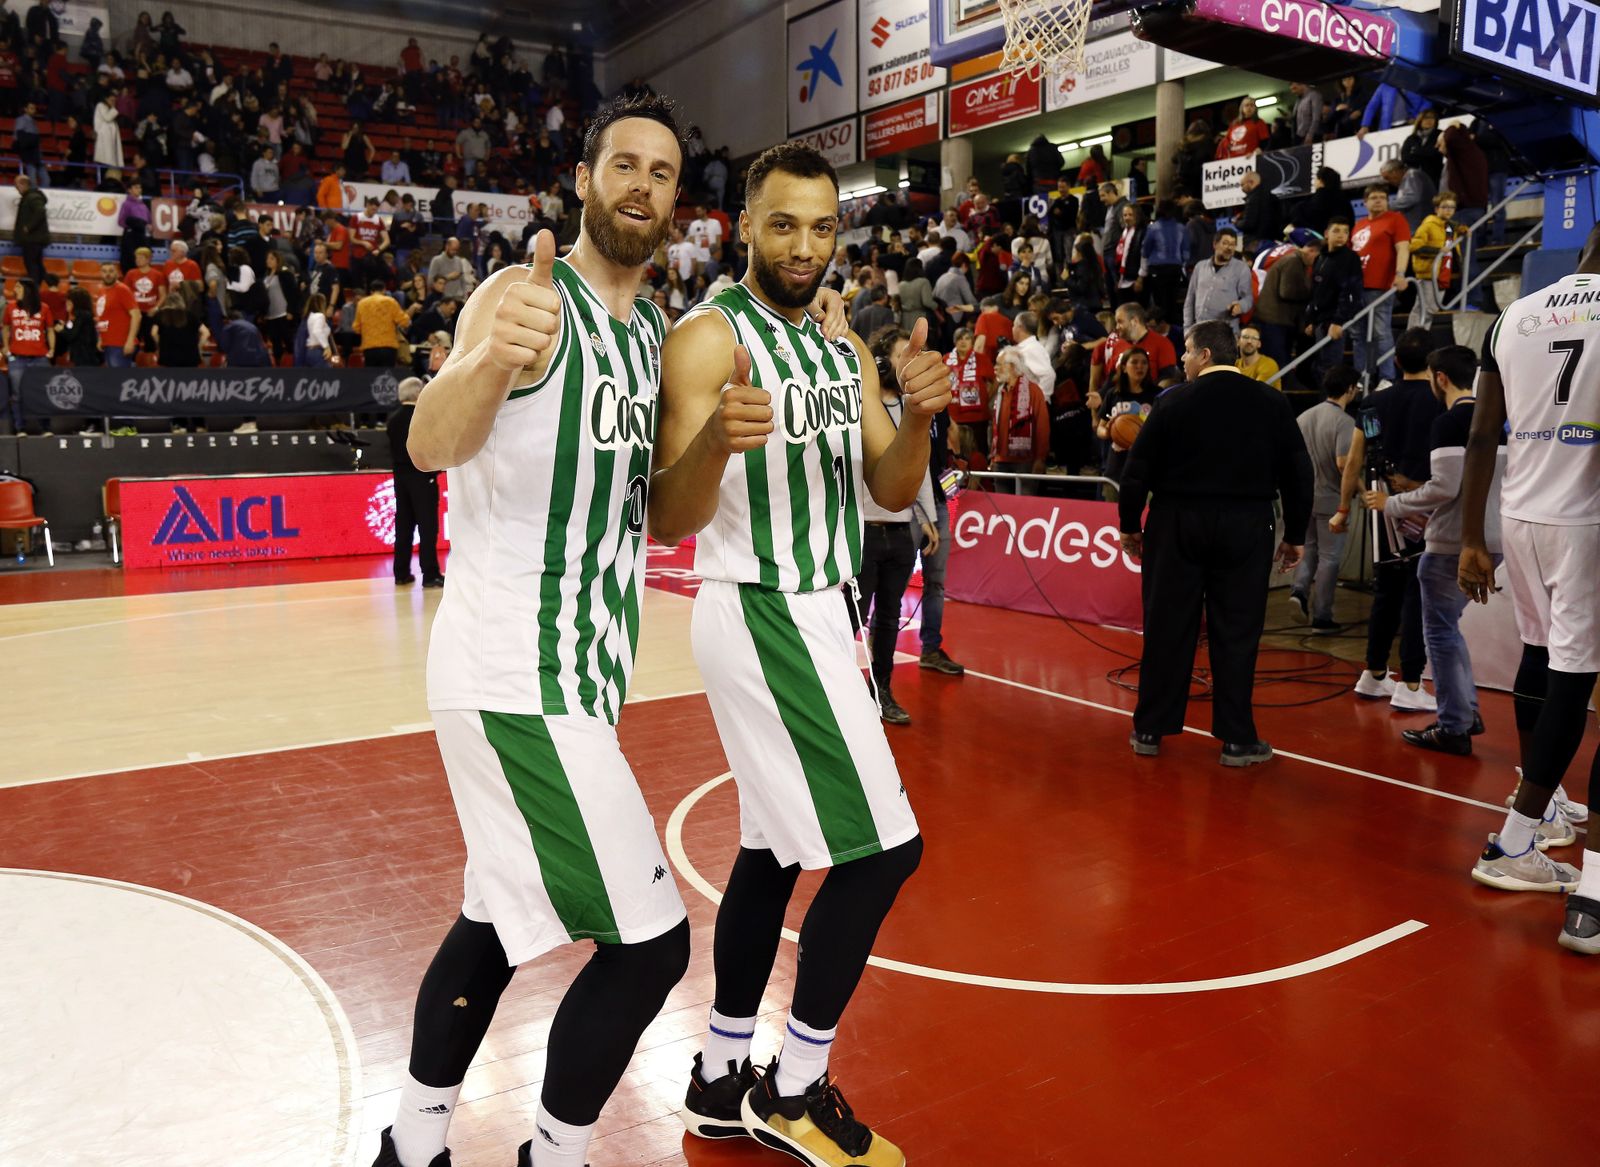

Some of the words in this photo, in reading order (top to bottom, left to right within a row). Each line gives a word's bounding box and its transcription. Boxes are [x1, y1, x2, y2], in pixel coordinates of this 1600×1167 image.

[894, 10, 929, 31] SUZUK
[1261, 0, 1384, 56] endesa
[1474, 0, 1597, 85] BAXI
[868, 77, 882, 97] 93
[883, 70, 902, 92] 877
[903, 65, 918, 86] 85
[1085, 58, 1131, 80] MIRALLES
[1204, 165, 1252, 181] kripton
[1563, 176, 1577, 230] MONDO
[1549, 338, 1585, 406] 7
[119, 375, 341, 404] BAXIMANRESA.COM
[1561, 427, 1594, 441] plus
